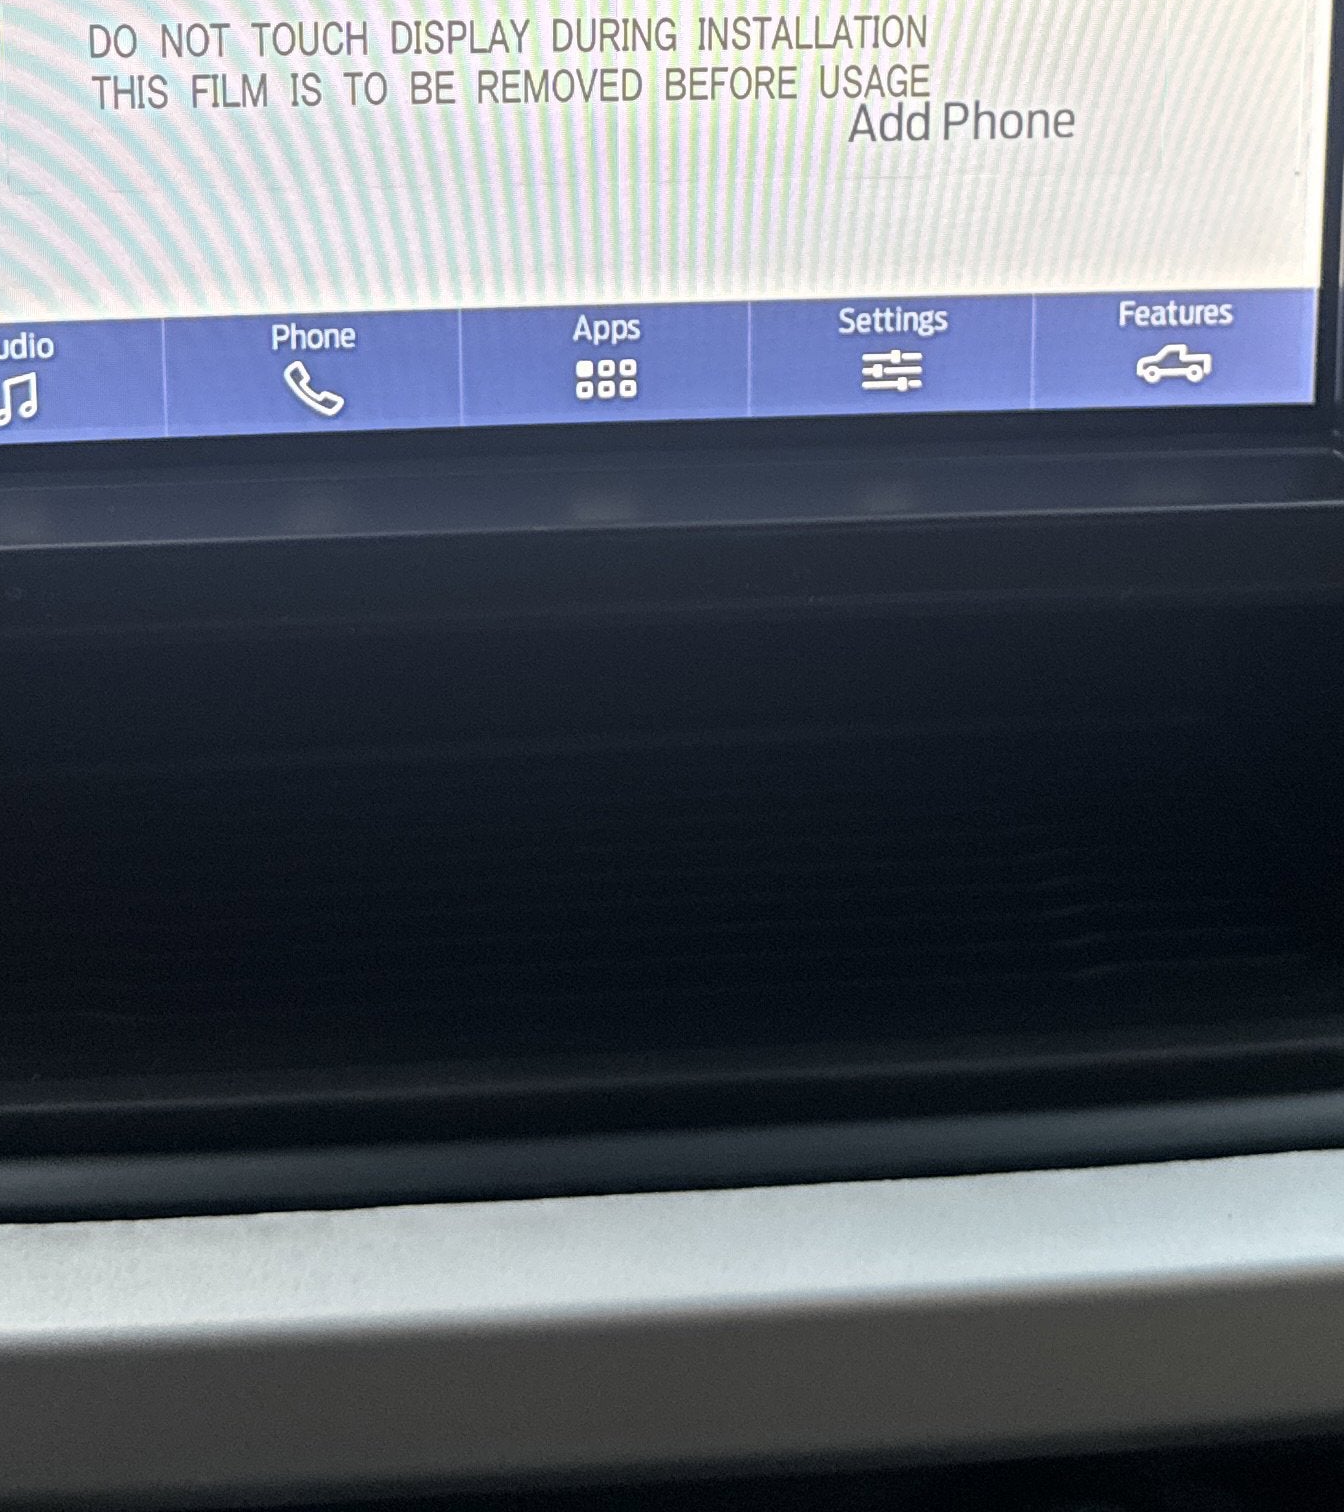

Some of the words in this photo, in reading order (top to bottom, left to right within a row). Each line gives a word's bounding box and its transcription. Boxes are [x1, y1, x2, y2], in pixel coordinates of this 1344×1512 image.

[88, 23, 138, 59] DO
[160, 22, 231, 59] NOT
[250, 20, 368, 57] TOUCH
[391, 19, 531, 55] DISPLAY
[552, 16, 678, 53] DURING
[697, 13, 928, 51] INSTALLATION
[90, 73, 169, 110] THIS
[191, 72, 268, 108] FILM
[290, 71, 322, 107] IS
[342, 70, 388, 106] TO
[410, 69, 457, 105] BE
[477, 67, 643, 104] REMOVED
[665, 65, 798, 102] BEFORE
[819, 63, 931, 100] USAGE
[847, 101, 931, 143] Add
[943, 100, 1076, 141] Phone
[838, 305, 949, 338] Settings
[1119, 298, 1234, 327] Features
[271, 322, 356, 352] Phone
[572, 313, 641, 346] Apps
